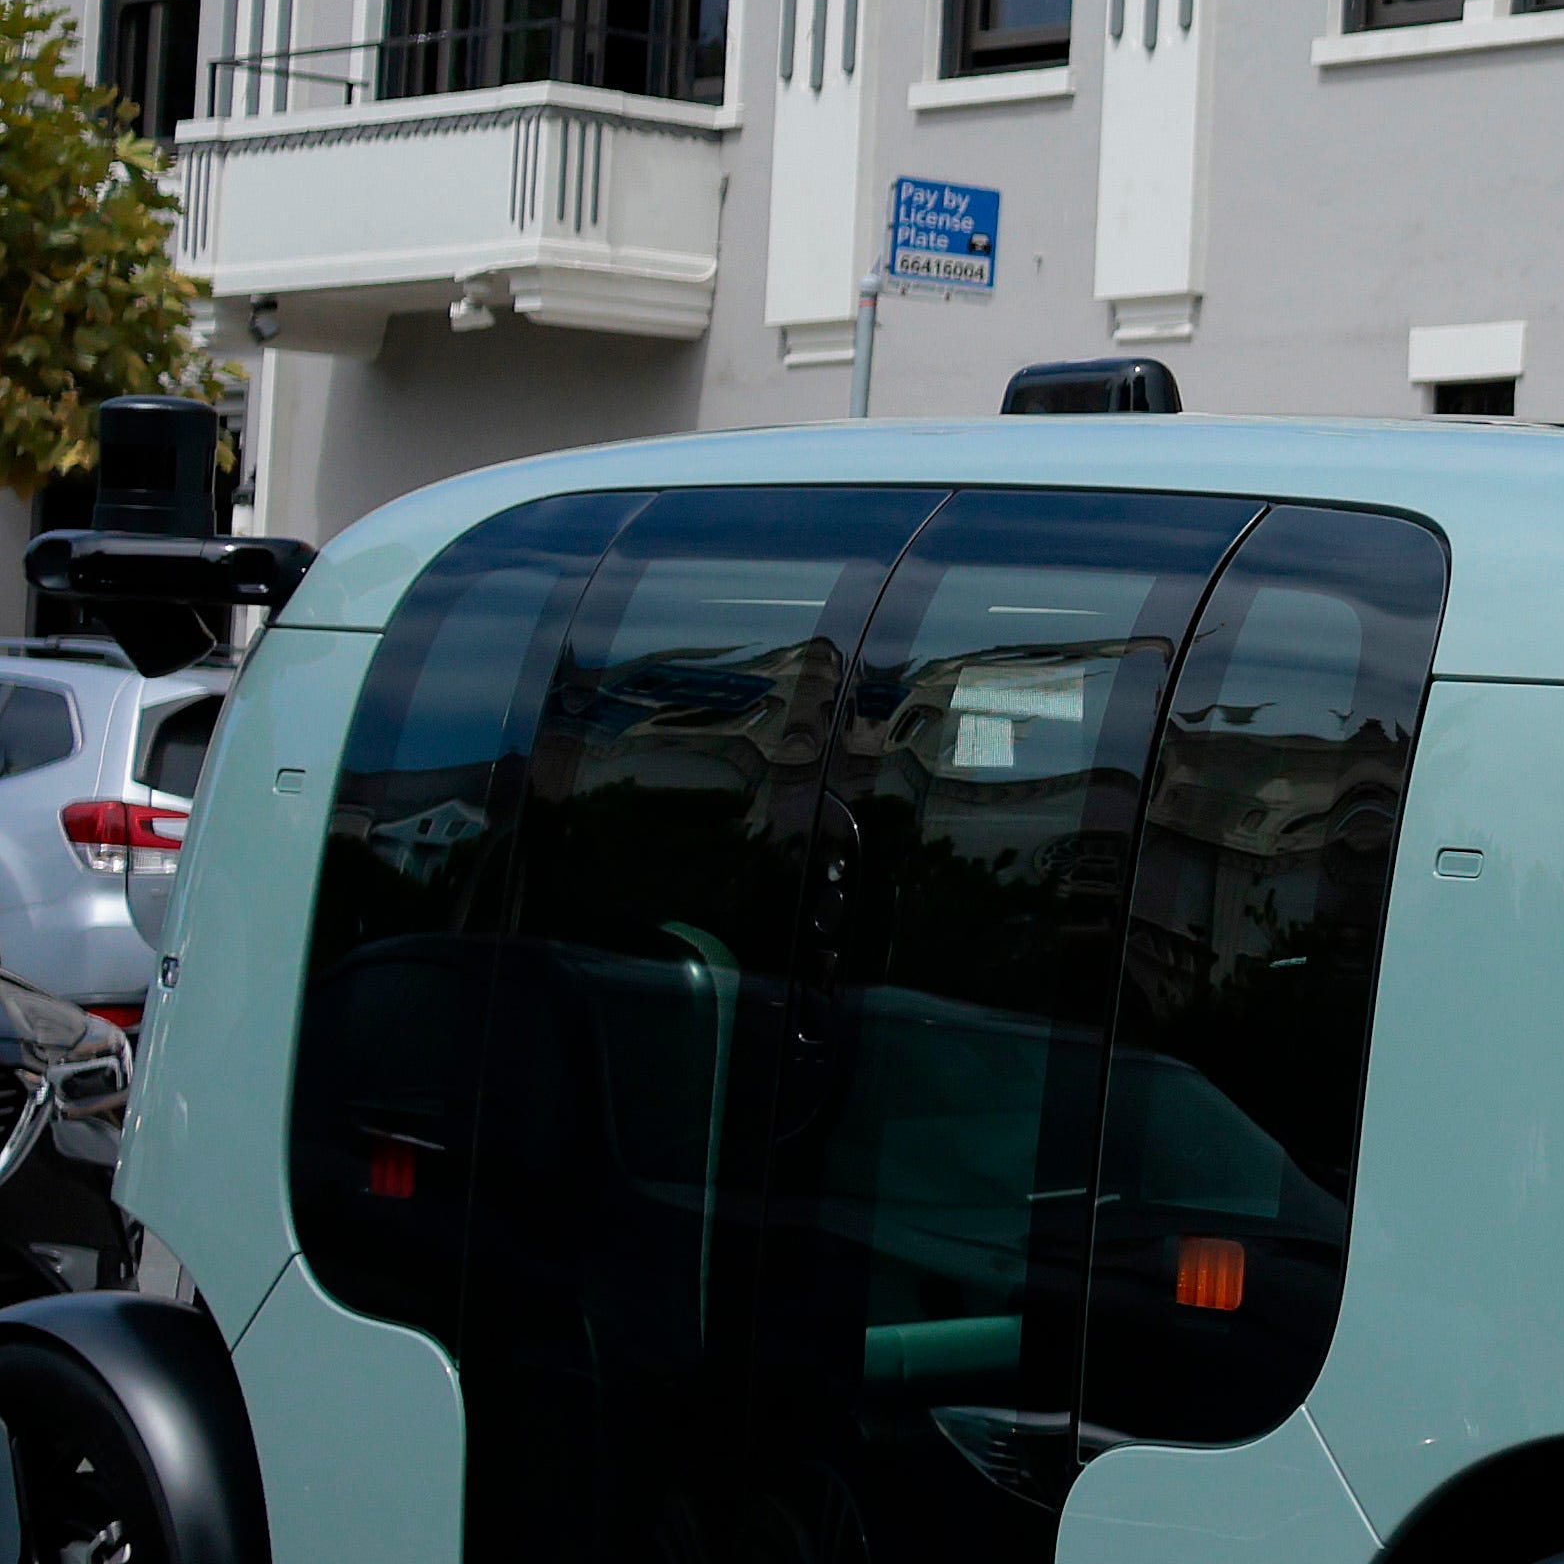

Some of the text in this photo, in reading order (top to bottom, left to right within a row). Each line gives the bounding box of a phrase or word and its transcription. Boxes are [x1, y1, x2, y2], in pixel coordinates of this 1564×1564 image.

[901, 182, 971, 214] Pay by
[900, 204, 975, 233] License
[897, 226, 949, 251] Plate
